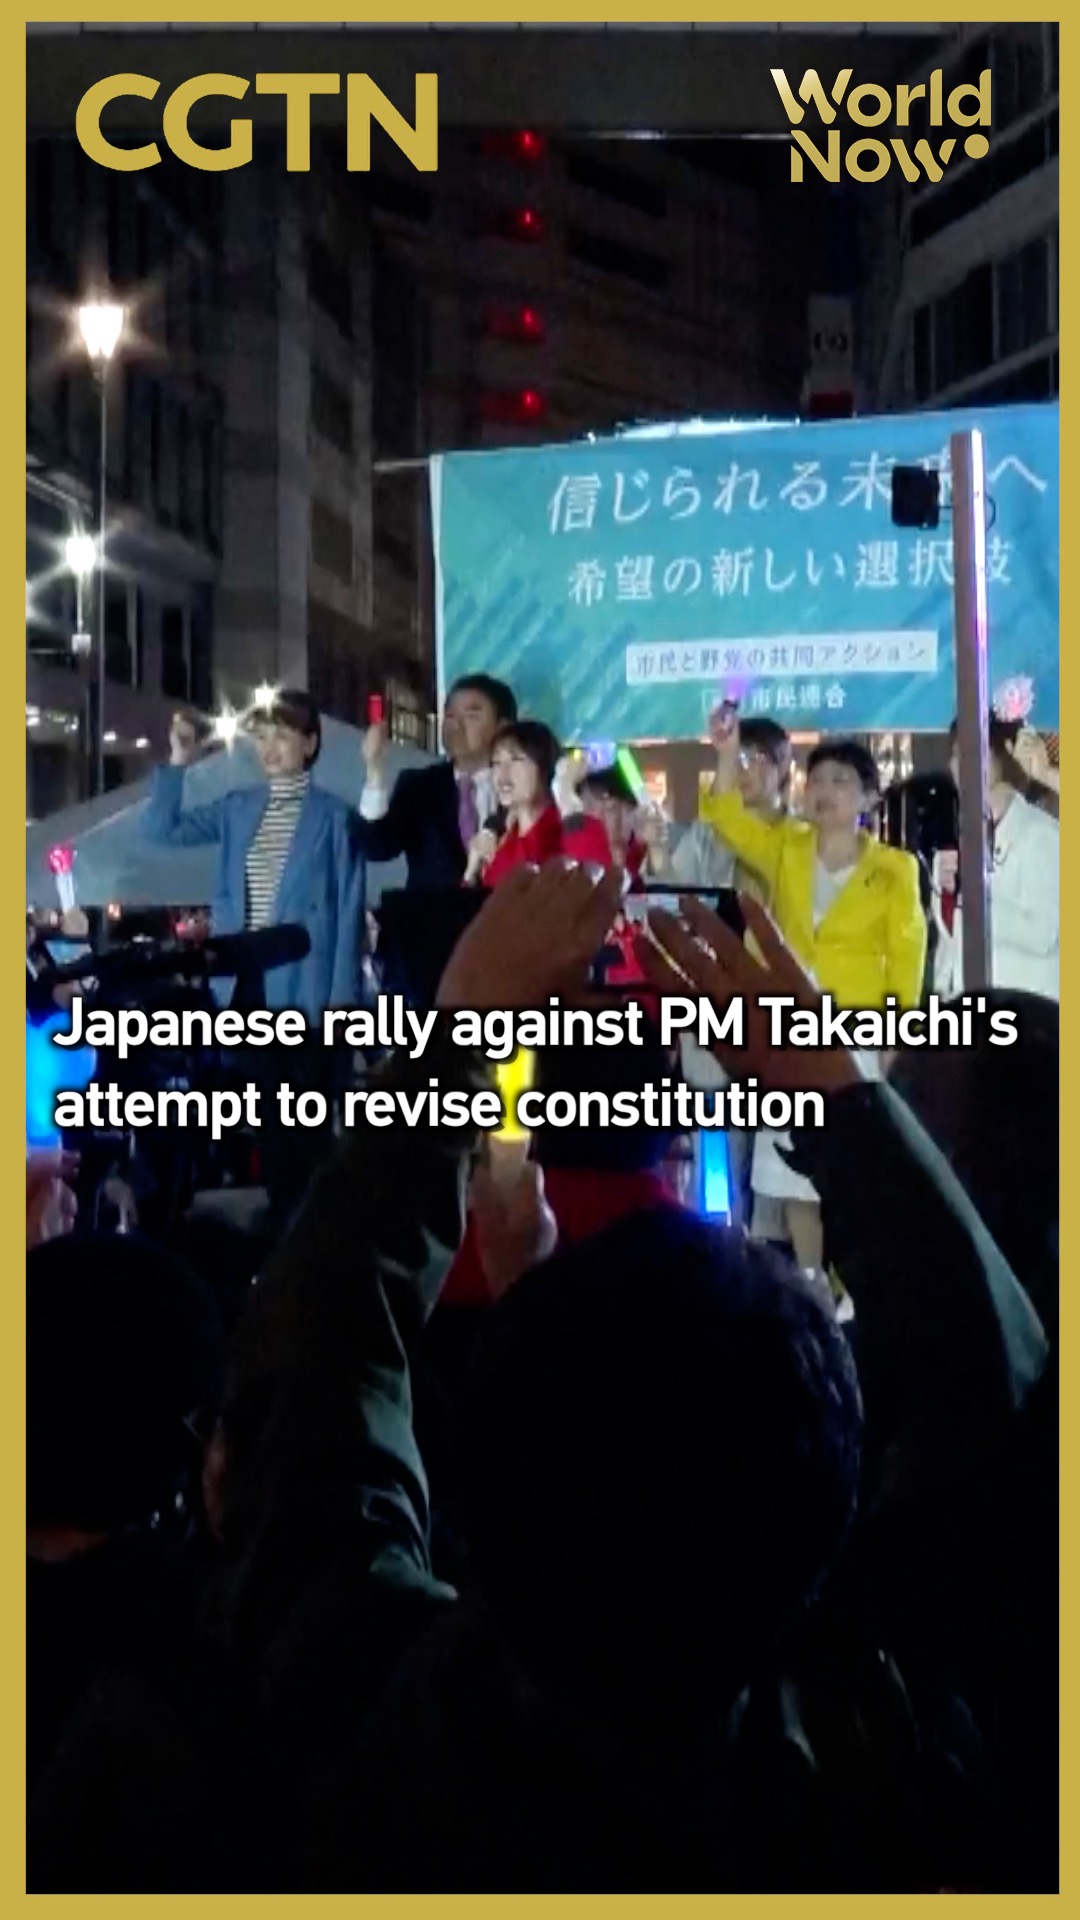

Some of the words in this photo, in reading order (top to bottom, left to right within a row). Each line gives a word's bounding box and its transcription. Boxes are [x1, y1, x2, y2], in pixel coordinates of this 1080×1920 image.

[547, 448, 1049, 535] 信じられる未へ
